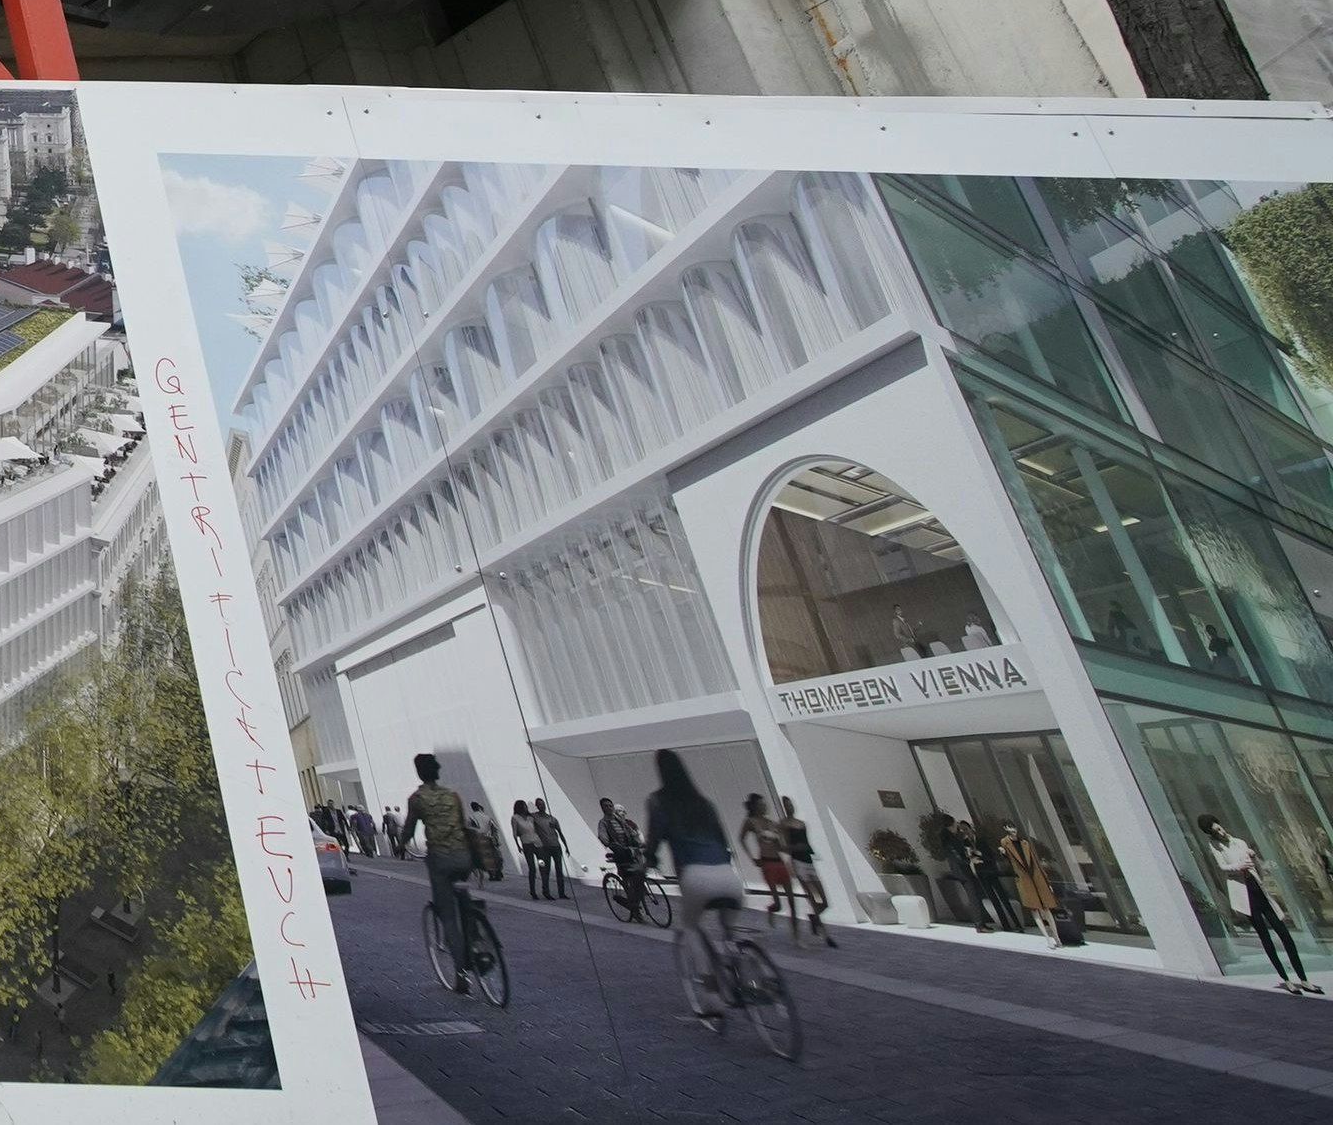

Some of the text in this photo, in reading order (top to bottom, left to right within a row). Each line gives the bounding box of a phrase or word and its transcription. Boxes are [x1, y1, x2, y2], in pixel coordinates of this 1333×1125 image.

[779, 657, 1028, 717] THOMPSON VIENNA
[253, 814, 332, 1002] EUCH
